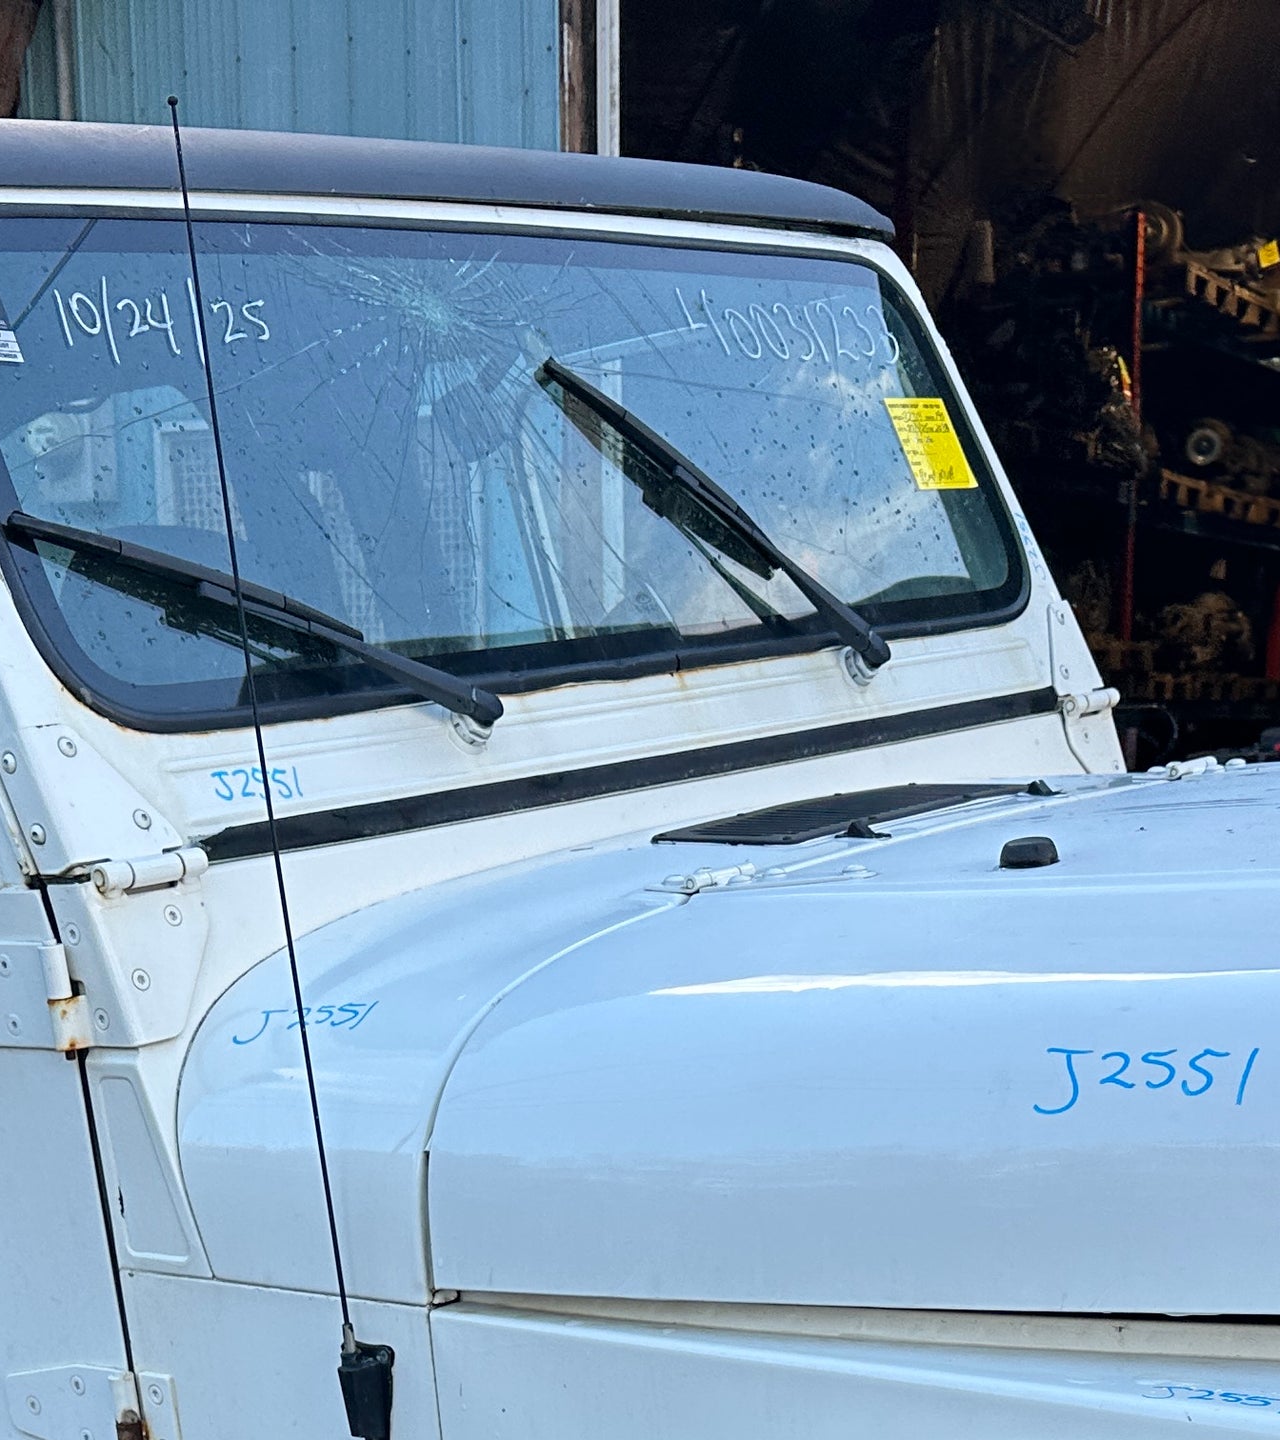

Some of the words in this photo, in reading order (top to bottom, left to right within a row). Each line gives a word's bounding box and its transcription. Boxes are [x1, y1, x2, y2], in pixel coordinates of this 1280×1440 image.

[54, 276, 270, 364] 10/24/25
[210, 767, 303, 801] J2551
[232, 1001, 380, 1045] J2551
[1033, 1047, 1260, 1115] J2551
